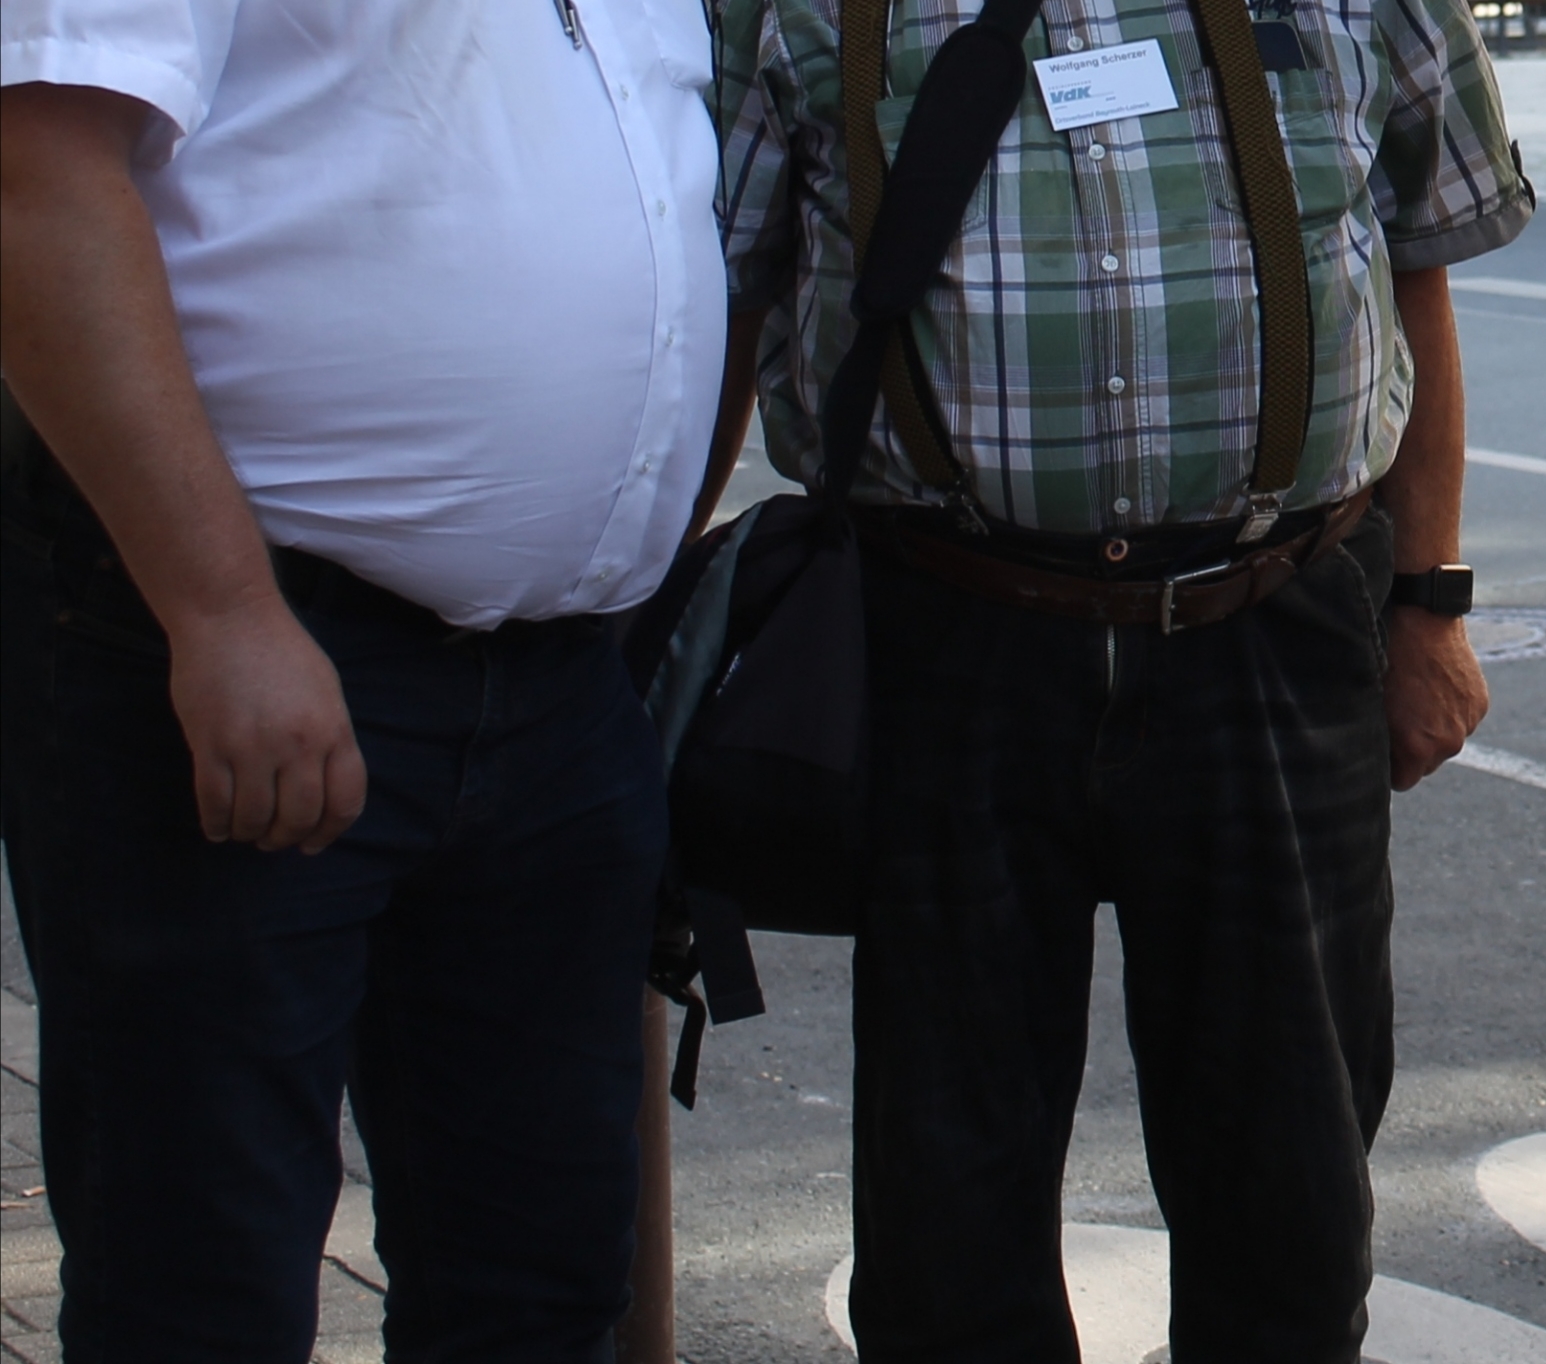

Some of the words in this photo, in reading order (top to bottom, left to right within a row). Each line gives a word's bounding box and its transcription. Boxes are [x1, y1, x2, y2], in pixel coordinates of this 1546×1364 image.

[1048, 57, 1099, 73] Wolfgang
[1100, 49, 1147, 64] Scherzer
[1050, 86, 1092, 104] VdK
